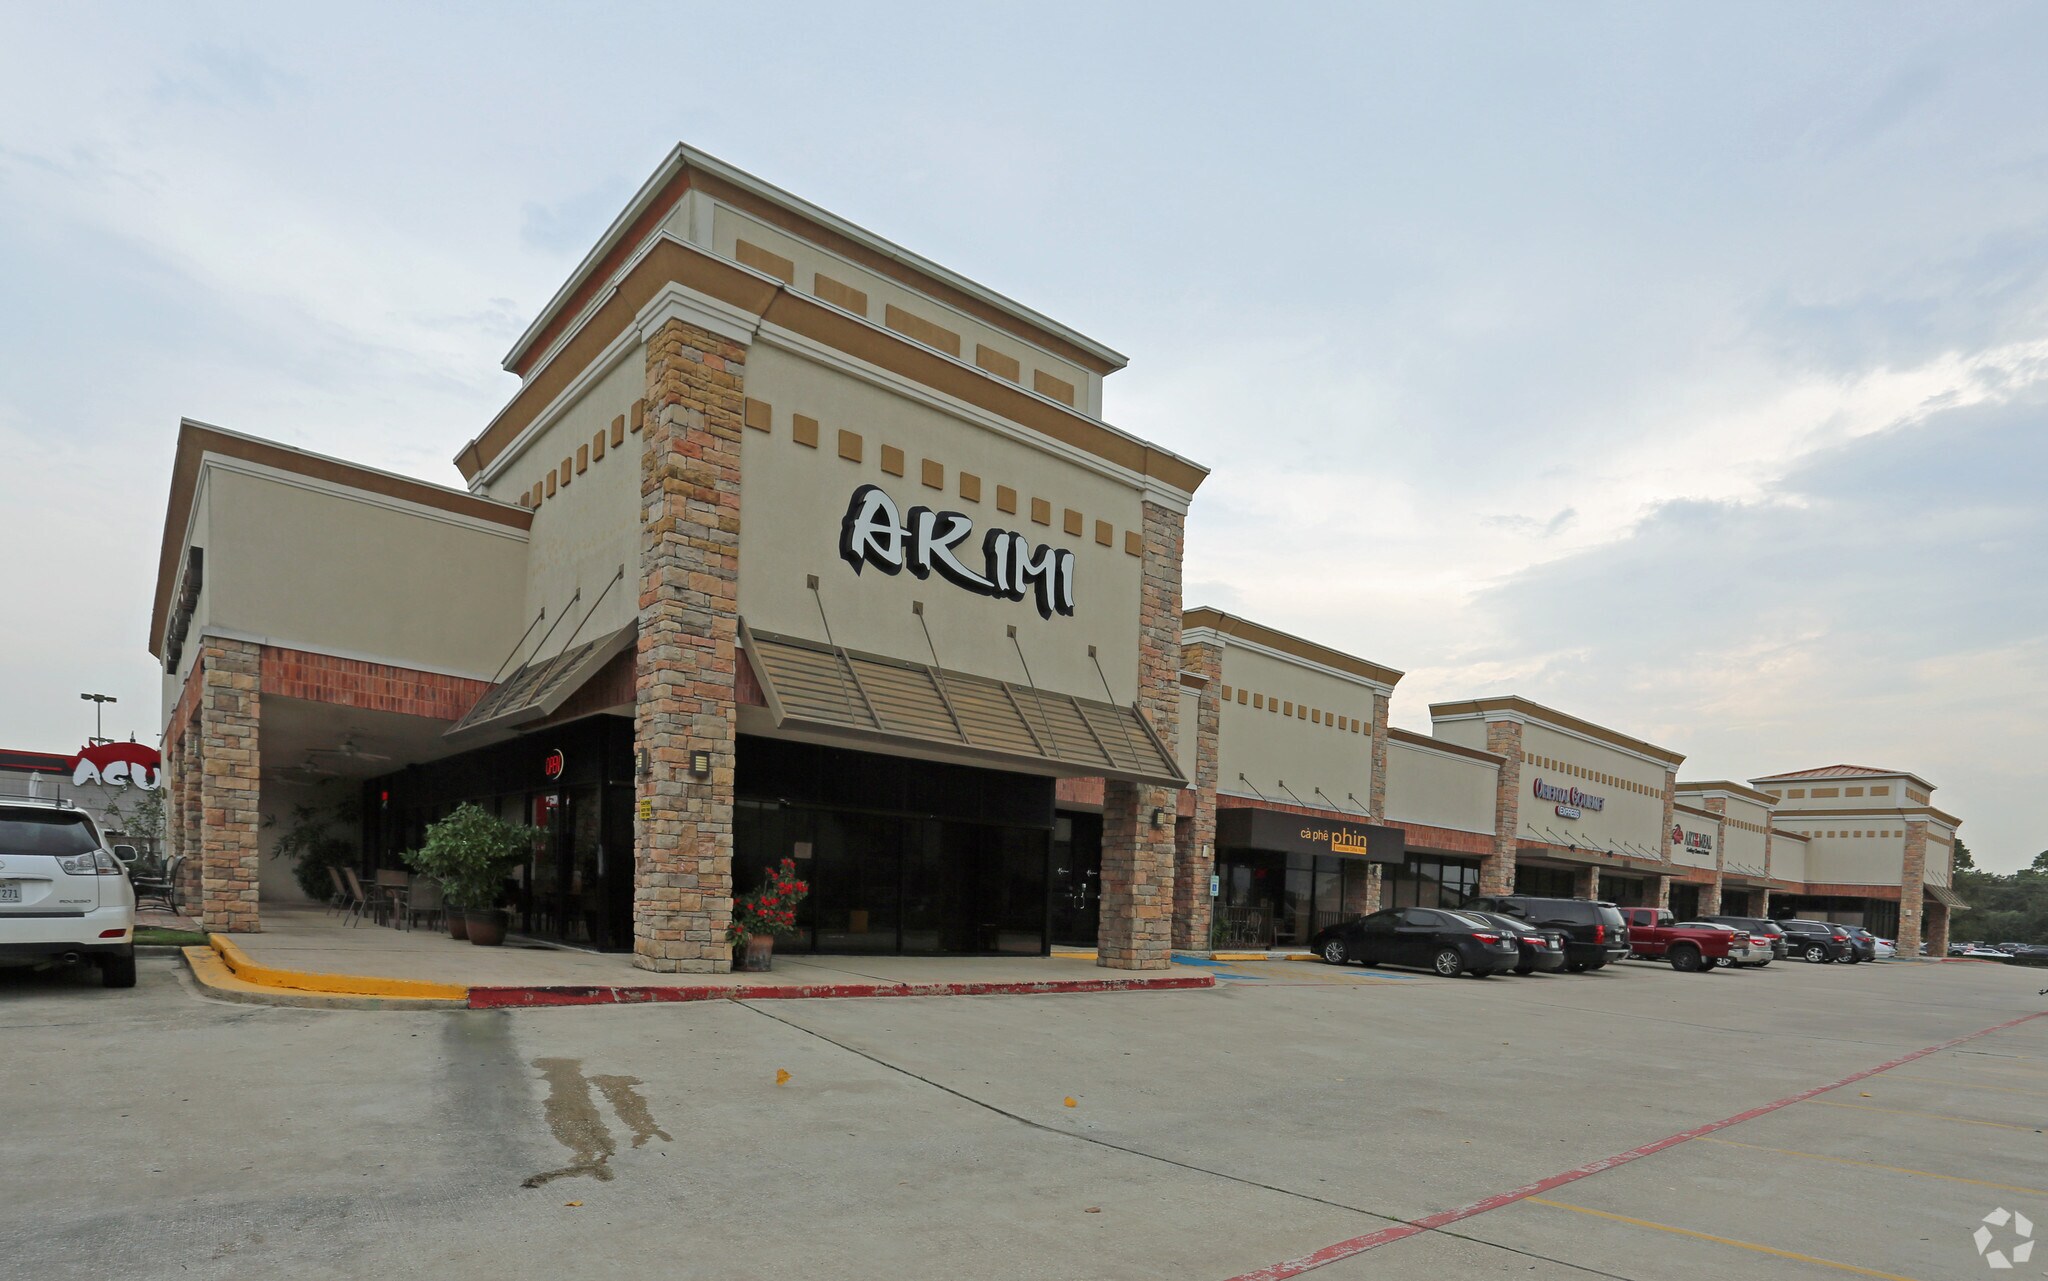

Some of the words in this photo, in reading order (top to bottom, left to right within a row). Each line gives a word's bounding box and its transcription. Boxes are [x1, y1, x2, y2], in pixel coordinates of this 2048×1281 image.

[839, 484, 1075, 621] AKIMI
[545, 754, 561, 776] OPEN
[1559, 806, 1580, 818] EXPRESS
[1331, 827, 1367, 852] phin
[0, 888, 19, 899] 271
